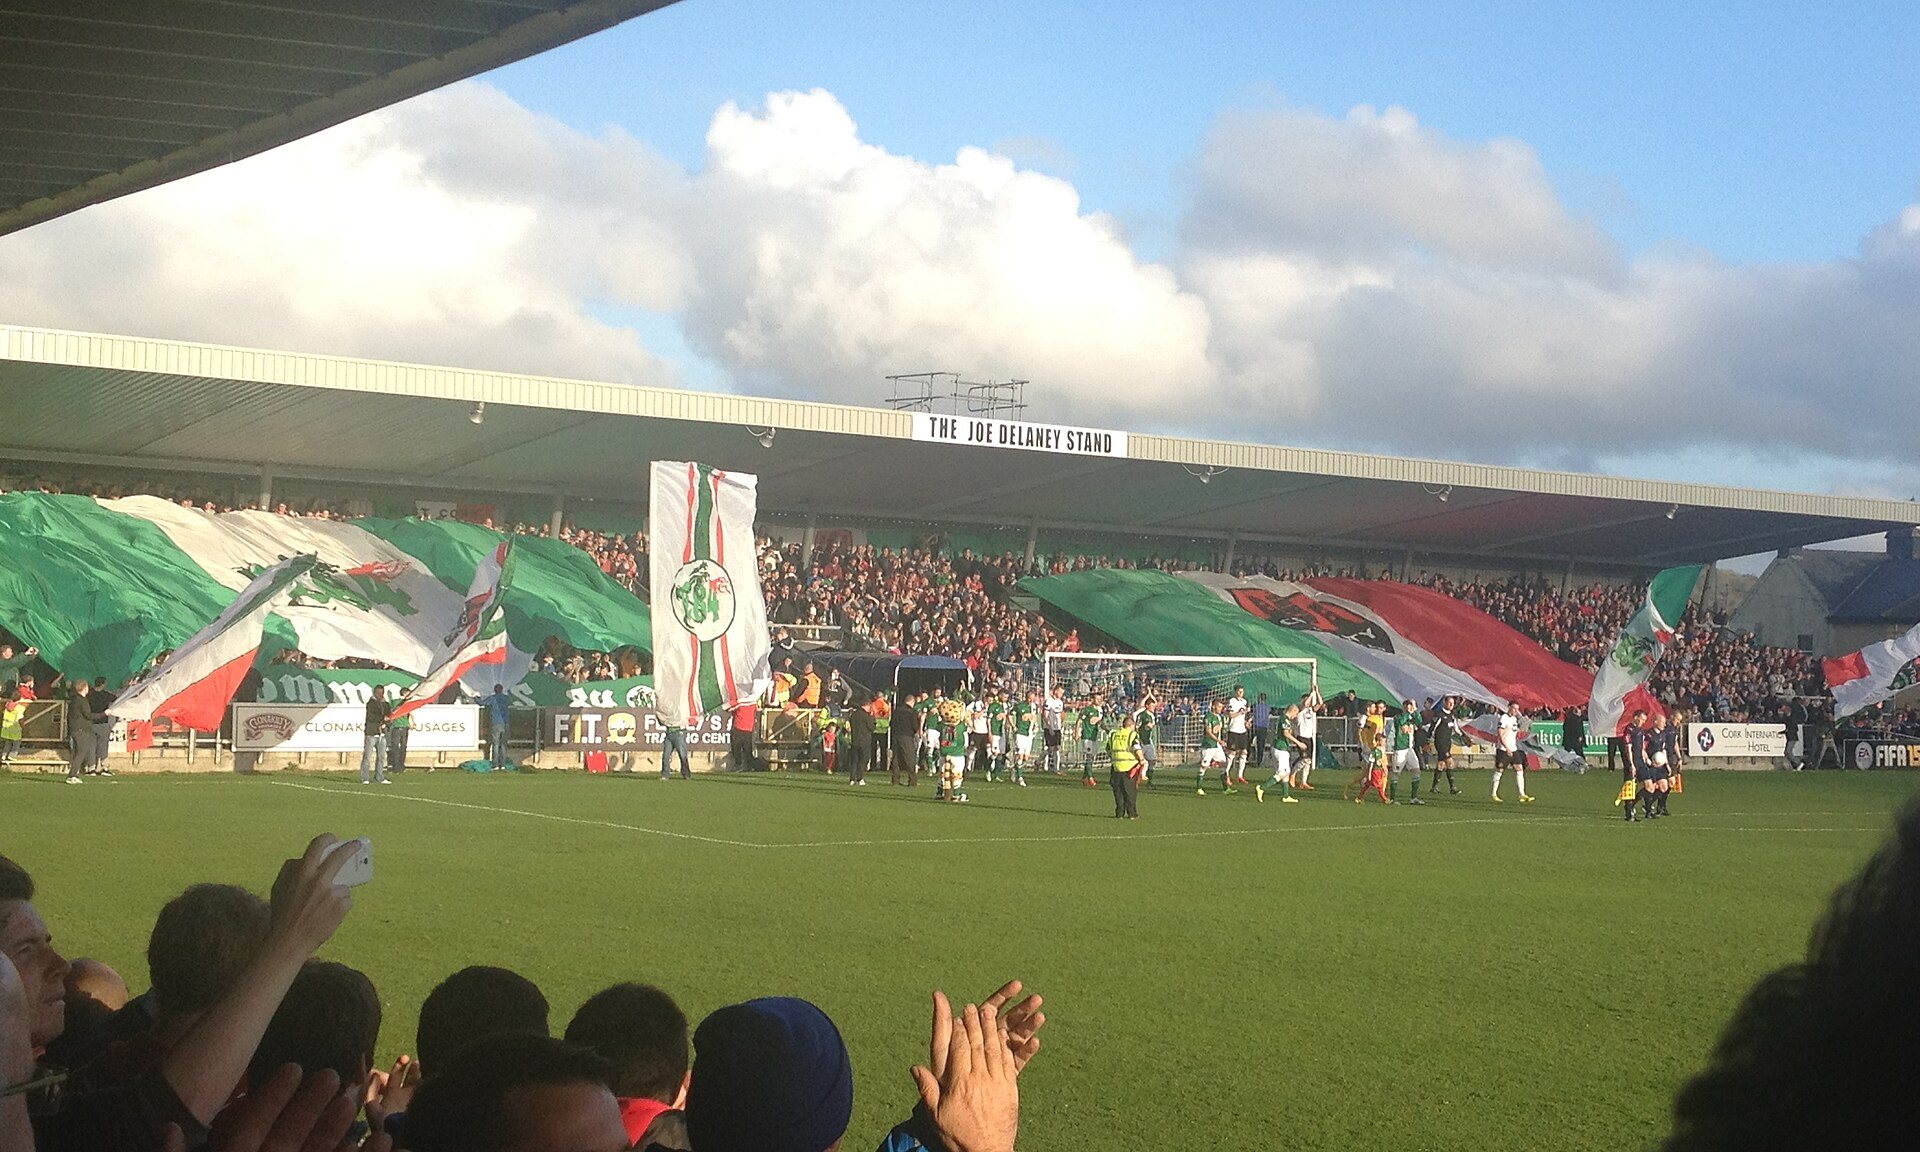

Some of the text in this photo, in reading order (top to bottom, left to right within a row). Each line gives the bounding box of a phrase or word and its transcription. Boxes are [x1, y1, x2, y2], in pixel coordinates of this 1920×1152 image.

[930, 416, 1112, 453] THE JOE DELANEY STAND
[305, 722, 466, 732] CLONAK USAGES
[1744, 727, 1785, 739] INTERNATI
[702, 732, 731, 744] CENT
[1747, 741, 1771, 752] HOTEL
